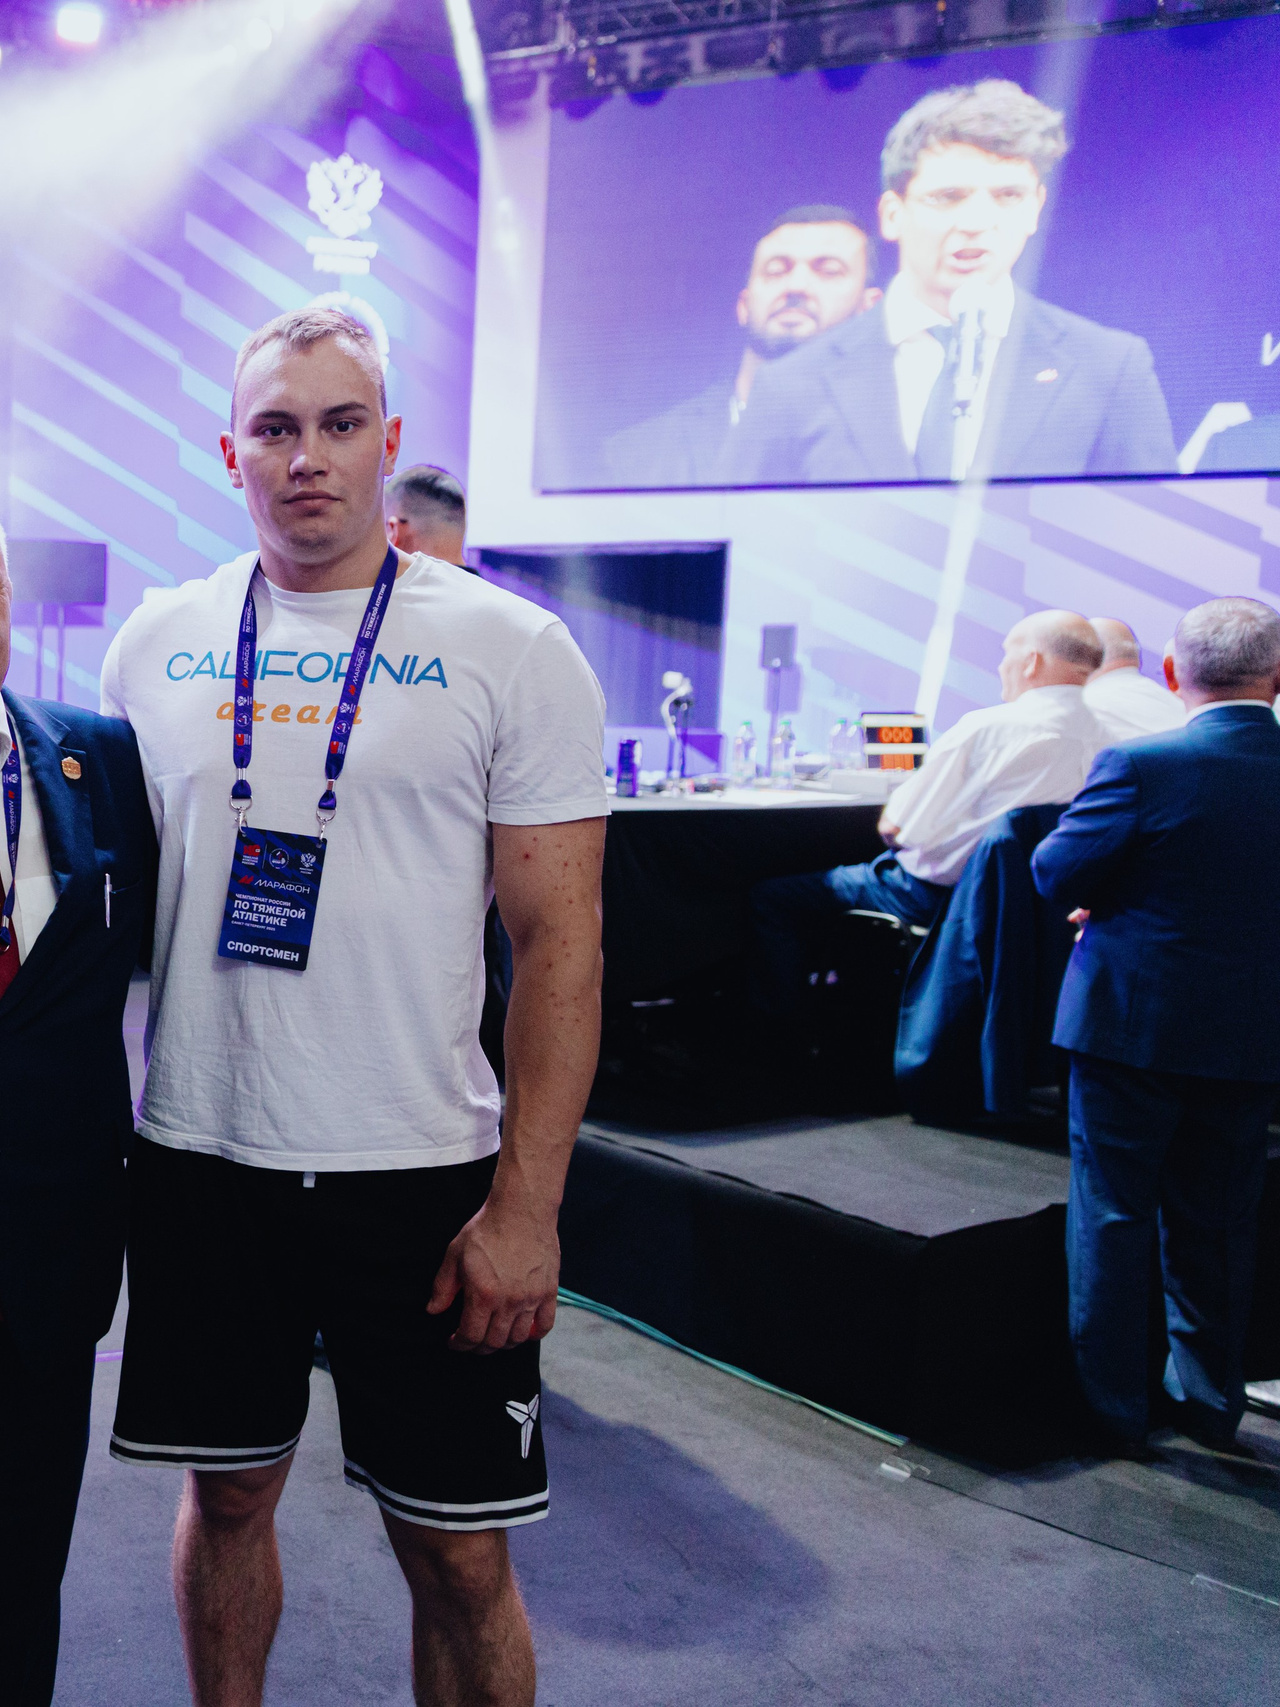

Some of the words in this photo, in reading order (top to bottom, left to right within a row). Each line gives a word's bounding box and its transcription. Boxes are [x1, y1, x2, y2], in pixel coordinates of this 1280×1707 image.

[352, 647, 367, 685] МАРАФОН
[254, 879, 311, 894] МАРАФОН
[235, 893, 268, 903] ЧЕМПИОНАТ
[268, 898, 291, 907] РОССИИ
[232, 910, 288, 927] АТЛЕТИКЕ
[234, 900, 250, 910] ПО
[252, 902, 306, 919] ТЯЖЕЛОЙ
[227, 940, 300, 962] СПОРТСМЕН
